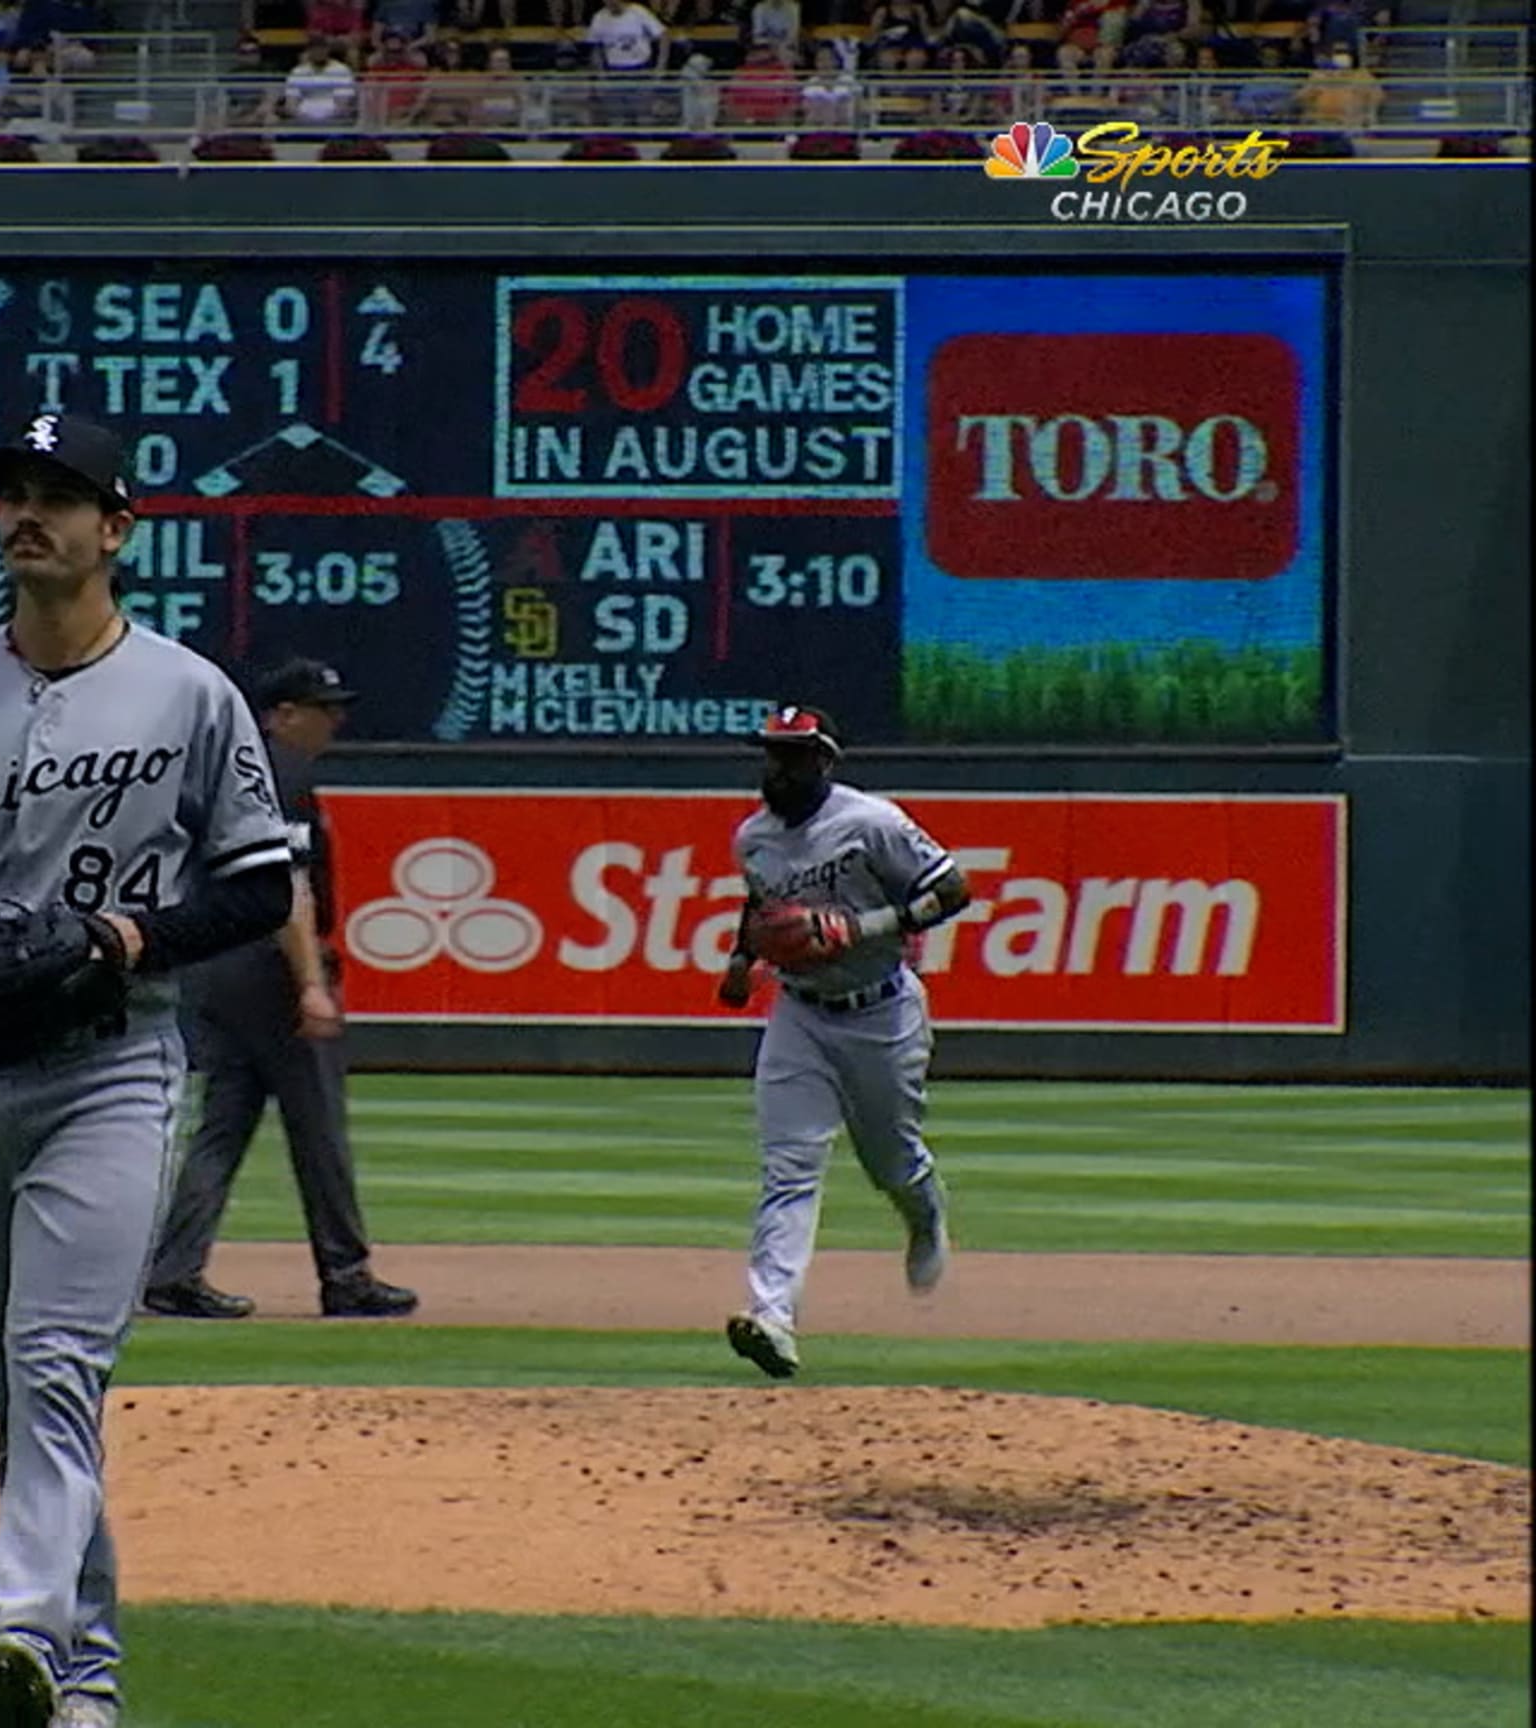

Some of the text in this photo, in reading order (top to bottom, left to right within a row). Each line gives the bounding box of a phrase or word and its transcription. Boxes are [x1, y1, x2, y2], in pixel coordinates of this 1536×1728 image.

[92, 283, 309, 343] SEA 0
[706, 305, 877, 355] HOME
[360, 321, 403, 375] 4
[511, 297, 686, 413] 20
[26, 353, 81, 412] T
[92, 356, 300, 415] TEX 1
[687, 363, 893, 414] GAMES
[135, 434, 178, 487] 0
[513, 426, 891, 480] IN AUGUST
[254, 552, 402, 605] 3:05
[579, 521, 706, 582] ARI
[745, 554, 879, 607] 3:10
[592, 595, 689, 653] SD
[64, 844, 161, 914] 84
[557, 842, 1261, 977] Sta Farm
